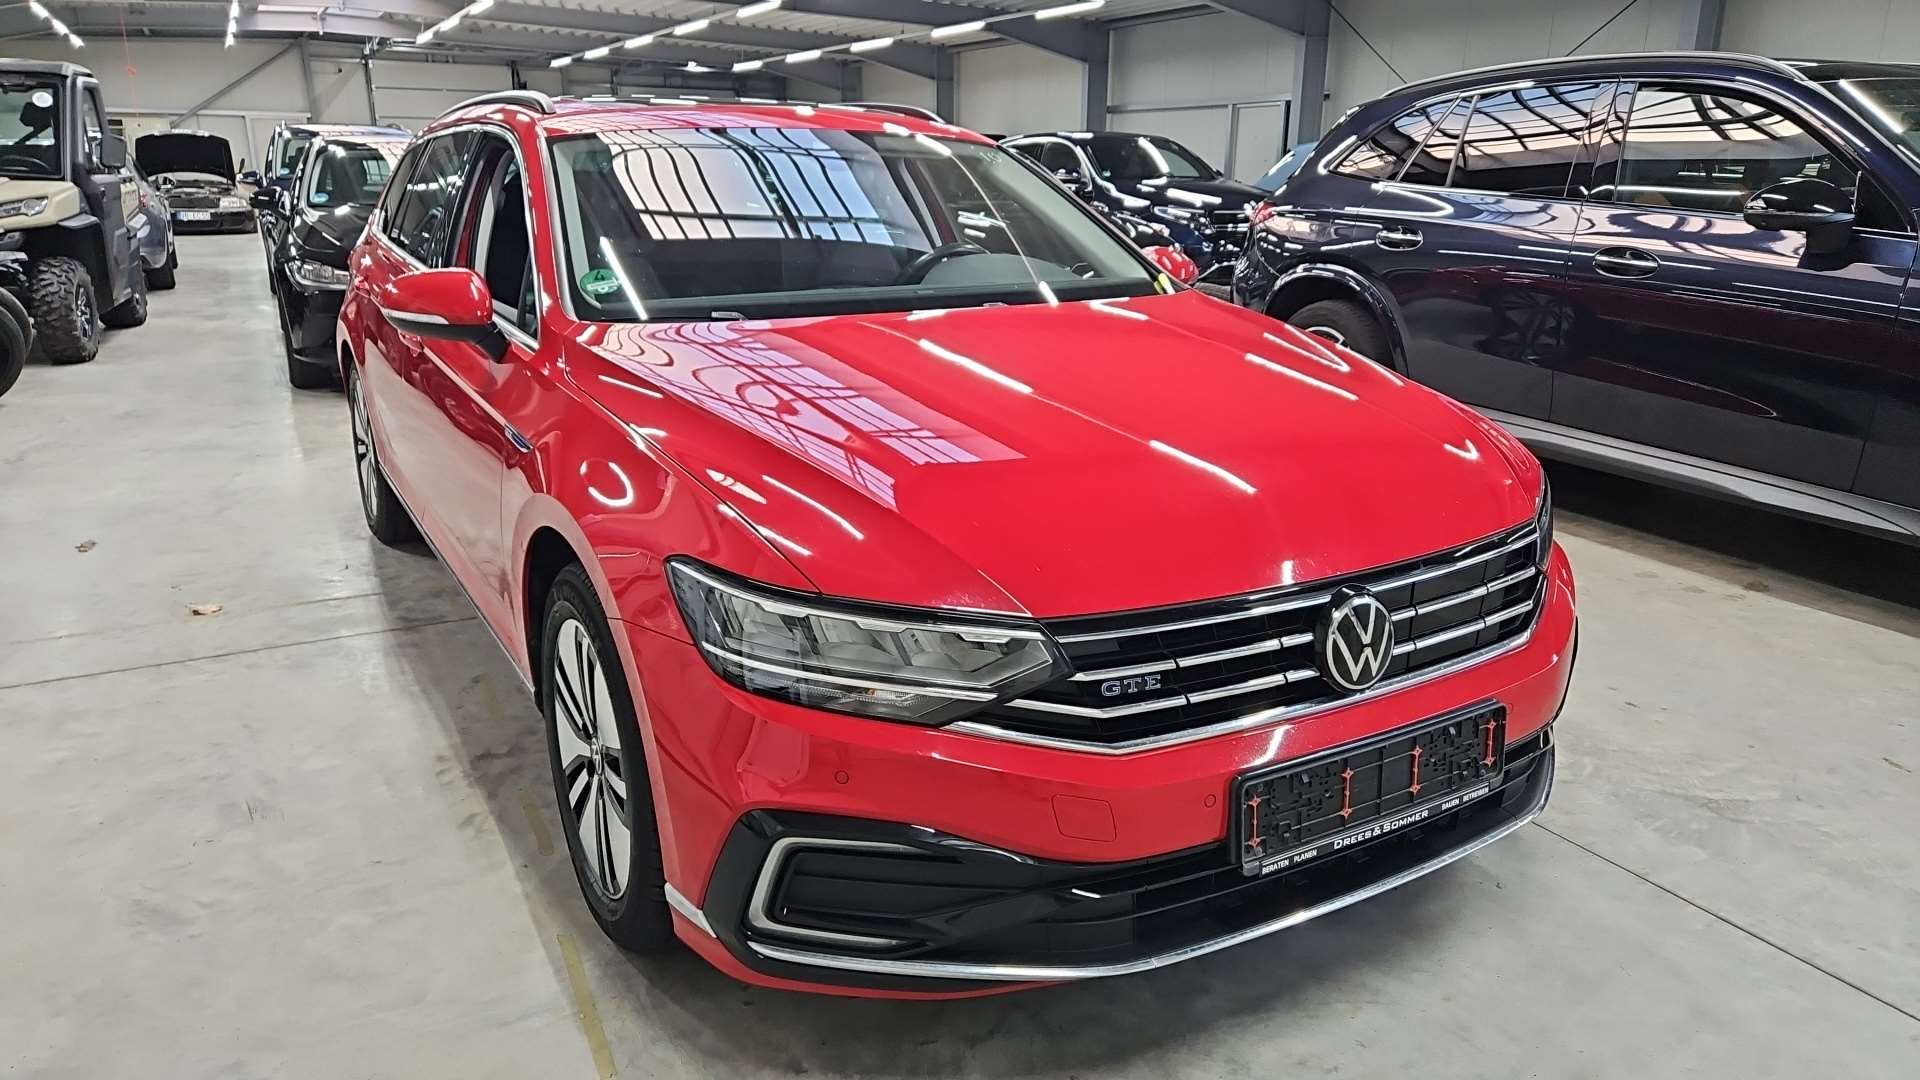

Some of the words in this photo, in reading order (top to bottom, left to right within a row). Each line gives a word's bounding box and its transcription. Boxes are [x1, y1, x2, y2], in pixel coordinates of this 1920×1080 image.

[1327, 596, 1392, 688] VW
[1101, 674, 1161, 697] GTE
[1261, 858, 1290, 875] BERATEN
[1293, 849, 1318, 863] PLANEN
